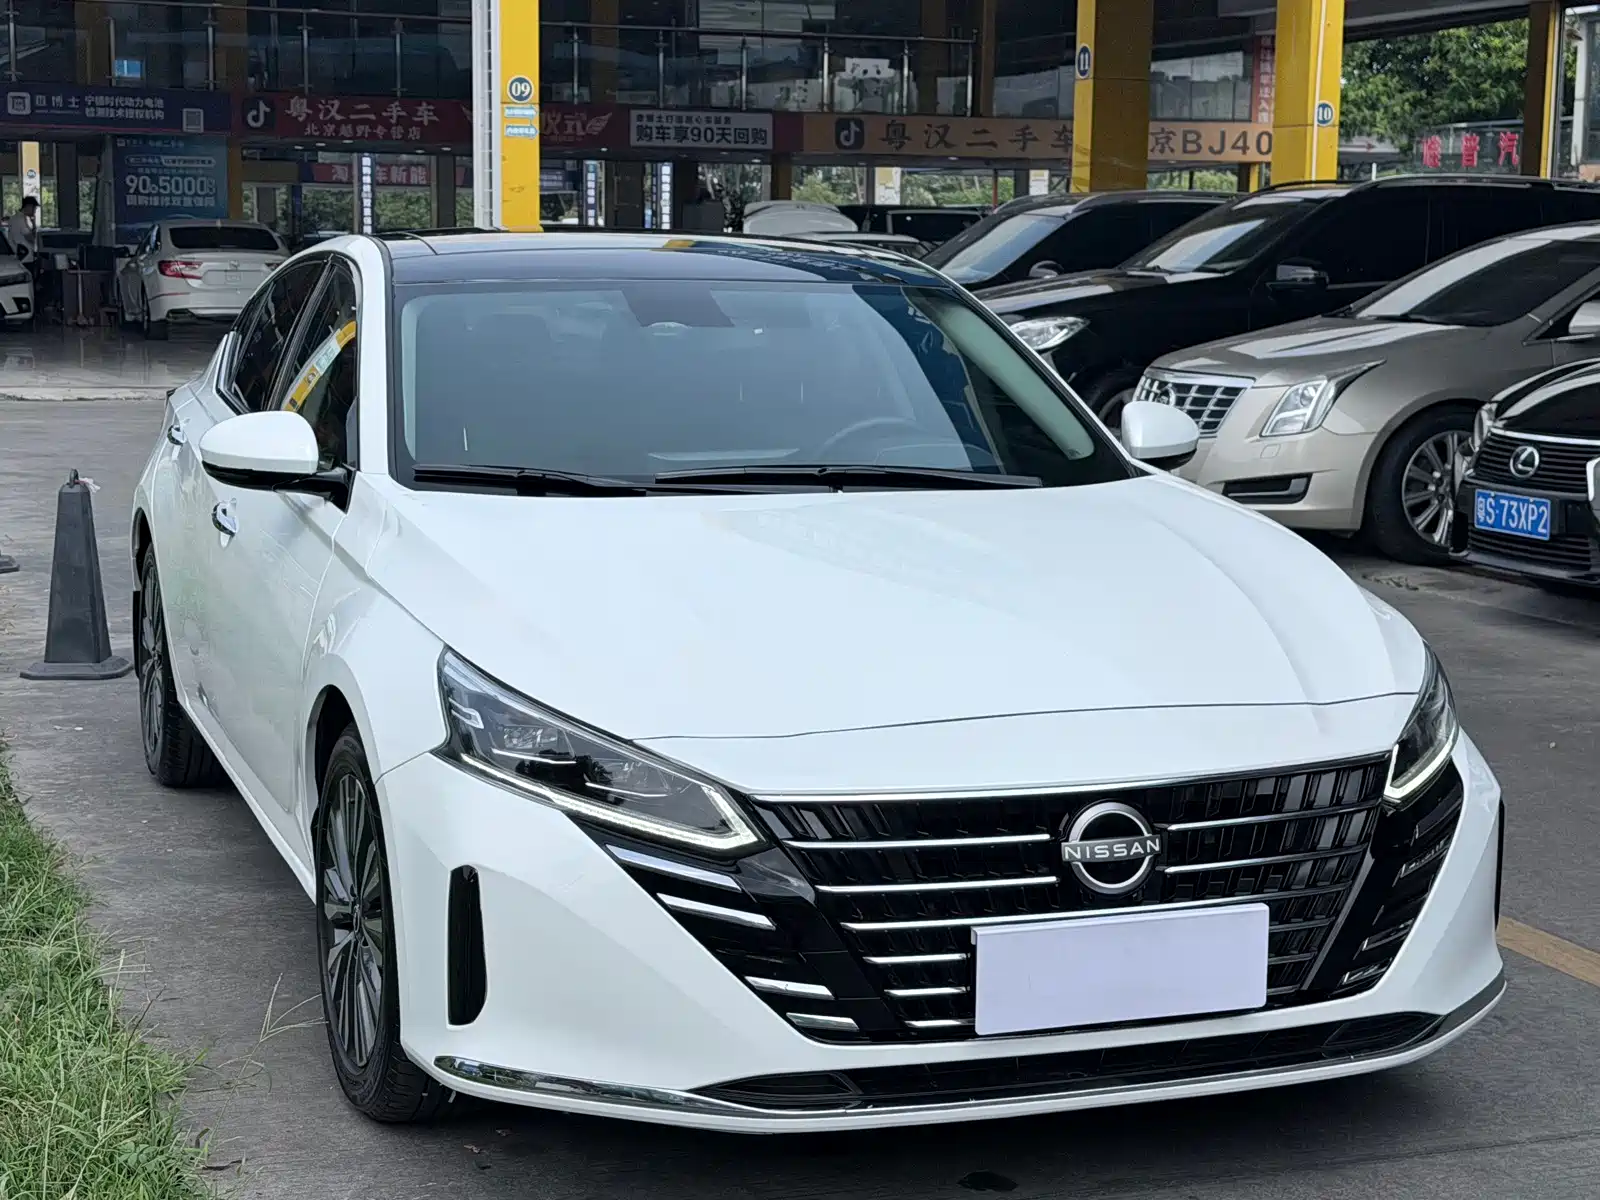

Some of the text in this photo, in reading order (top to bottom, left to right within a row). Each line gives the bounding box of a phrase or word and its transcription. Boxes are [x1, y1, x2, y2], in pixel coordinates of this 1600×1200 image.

[1079, 51, 1090, 71] 11
[511, 82, 531, 97] 09
[284, 95, 440, 127] 粤汉二手车
[1318, 107, 1332, 123] 10
[635, 125, 768, 145] 购车享90天回购
[878, 119, 1073, 152] 粤汉二手车
[332, 164, 427, 184] 淘车新能
[1064, 838, 1160, 860] NISSAN
